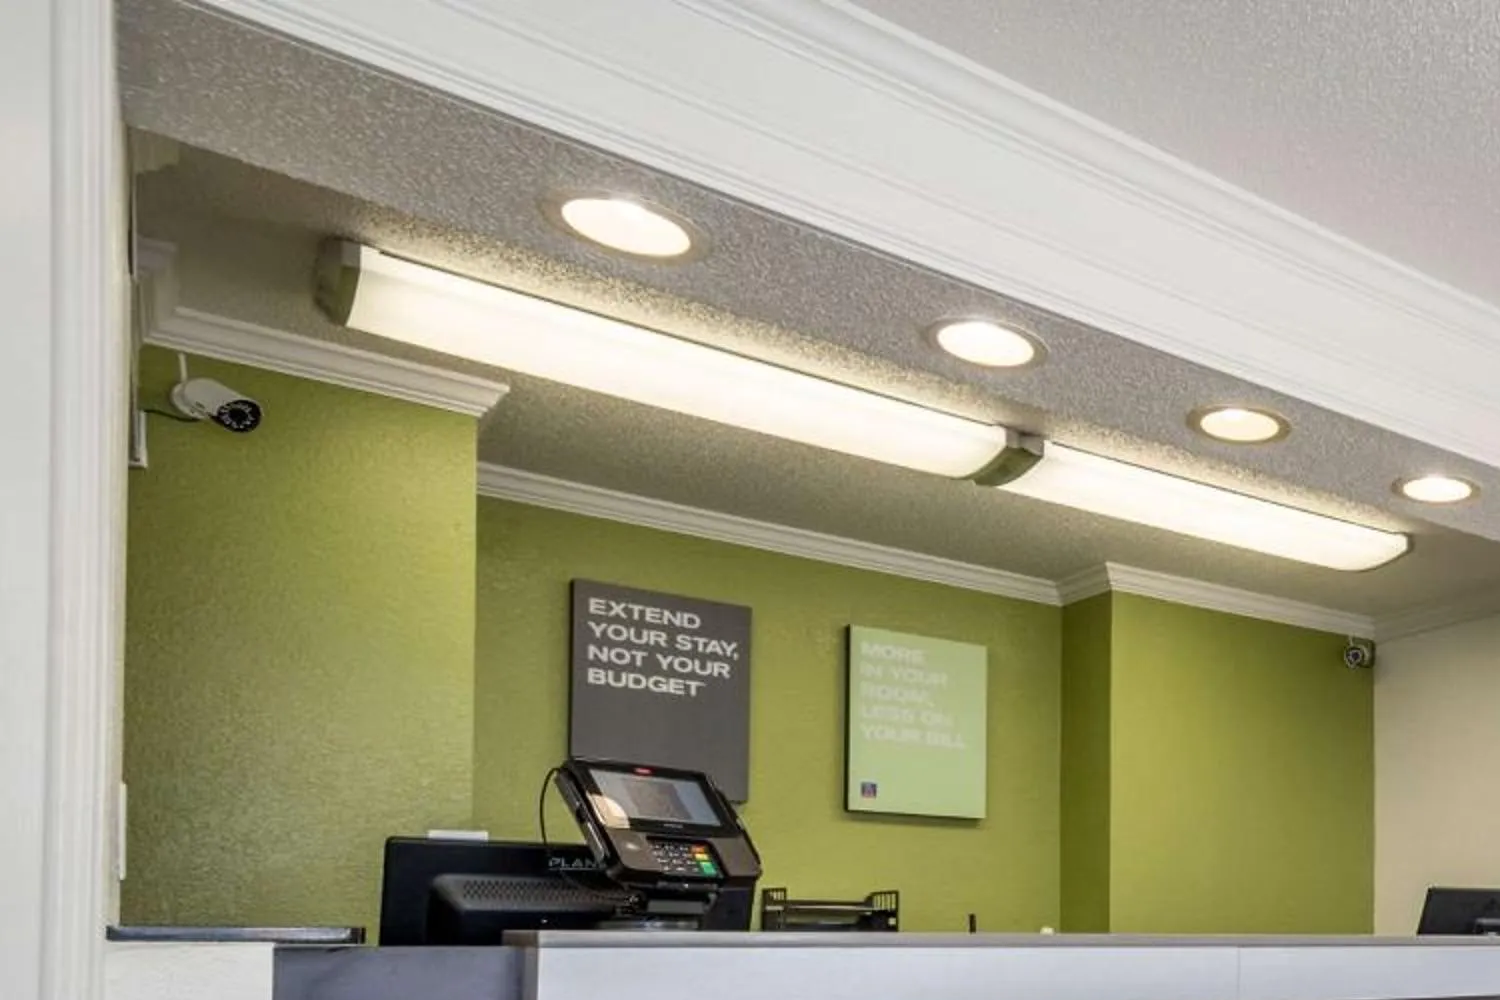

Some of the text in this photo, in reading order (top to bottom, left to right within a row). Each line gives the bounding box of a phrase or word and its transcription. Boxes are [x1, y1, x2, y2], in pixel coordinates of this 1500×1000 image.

[587, 597, 701, 629] EXTEND
[587, 621, 740, 660] YOUR STAY,
[587, 644, 731, 679] NOT YOUR
[587, 666, 705, 697] BUDGET
[548, 857, 602, 868] PLAN
